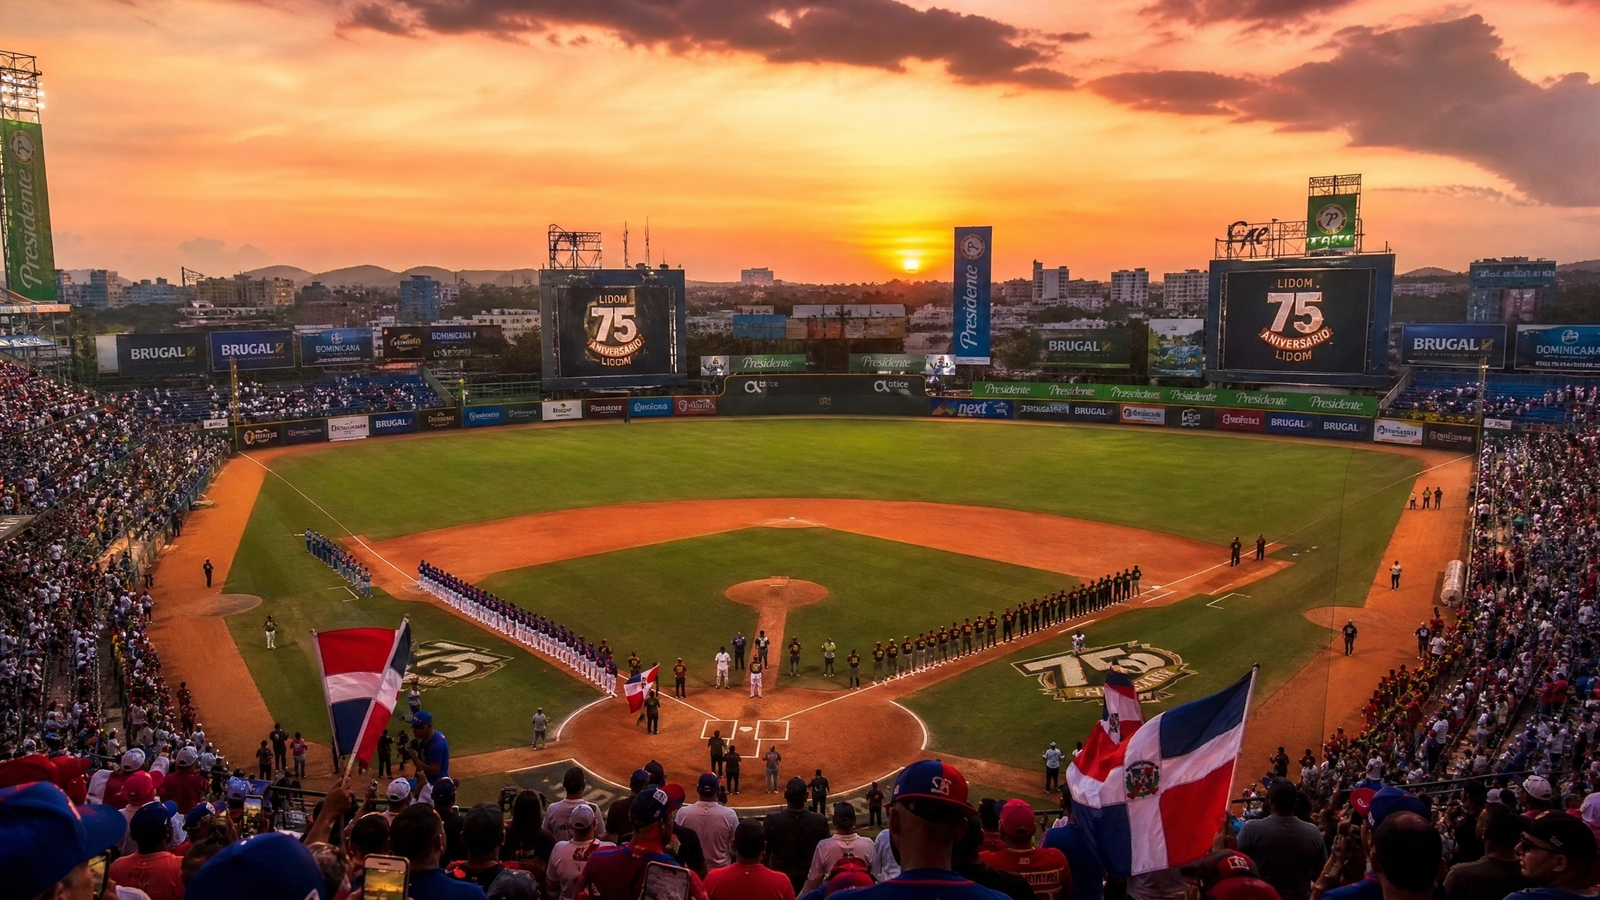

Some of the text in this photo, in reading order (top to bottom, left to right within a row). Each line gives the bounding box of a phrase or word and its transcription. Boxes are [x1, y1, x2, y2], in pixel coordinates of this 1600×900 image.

[16, 168, 43, 290] Presidente
[1277, 278, 1313, 288] LIDOM
[599, 295, 627, 304] LIDOM
[960, 264, 978, 350] Presidente
[1267, 291, 1325, 334] 75
[591, 306, 638, 343] 75
[1260, 327, 1331, 349] ANIVERSARIO
[1413, 338, 1479, 351] BRUGAL
[221, 343, 274, 356] BRUGAL
[589, 337, 643, 357] ANIVERSARIO
[1049, 340, 1100, 352] BRUGAL
[130, 346, 186, 360] BRUGAL
[1275, 350, 1312, 362] LIDOM
[742, 356, 793, 369] Presidente
[861, 355, 911, 368] Presidente
[984, 383, 1031, 395] Presidente
[1049, 384, 1095, 397] Presidente
[1235, 392, 1288, 406] Presidente
[1309, 395, 1364, 411] Presidente
[958, 401, 988, 414] next
[1074, 406, 1107, 416] BRUGAL
[375, 418, 408, 429] BRUGAL
[1271, 418, 1306, 429] BRUGAL
[1323, 421, 1359, 432] BRUGAL
